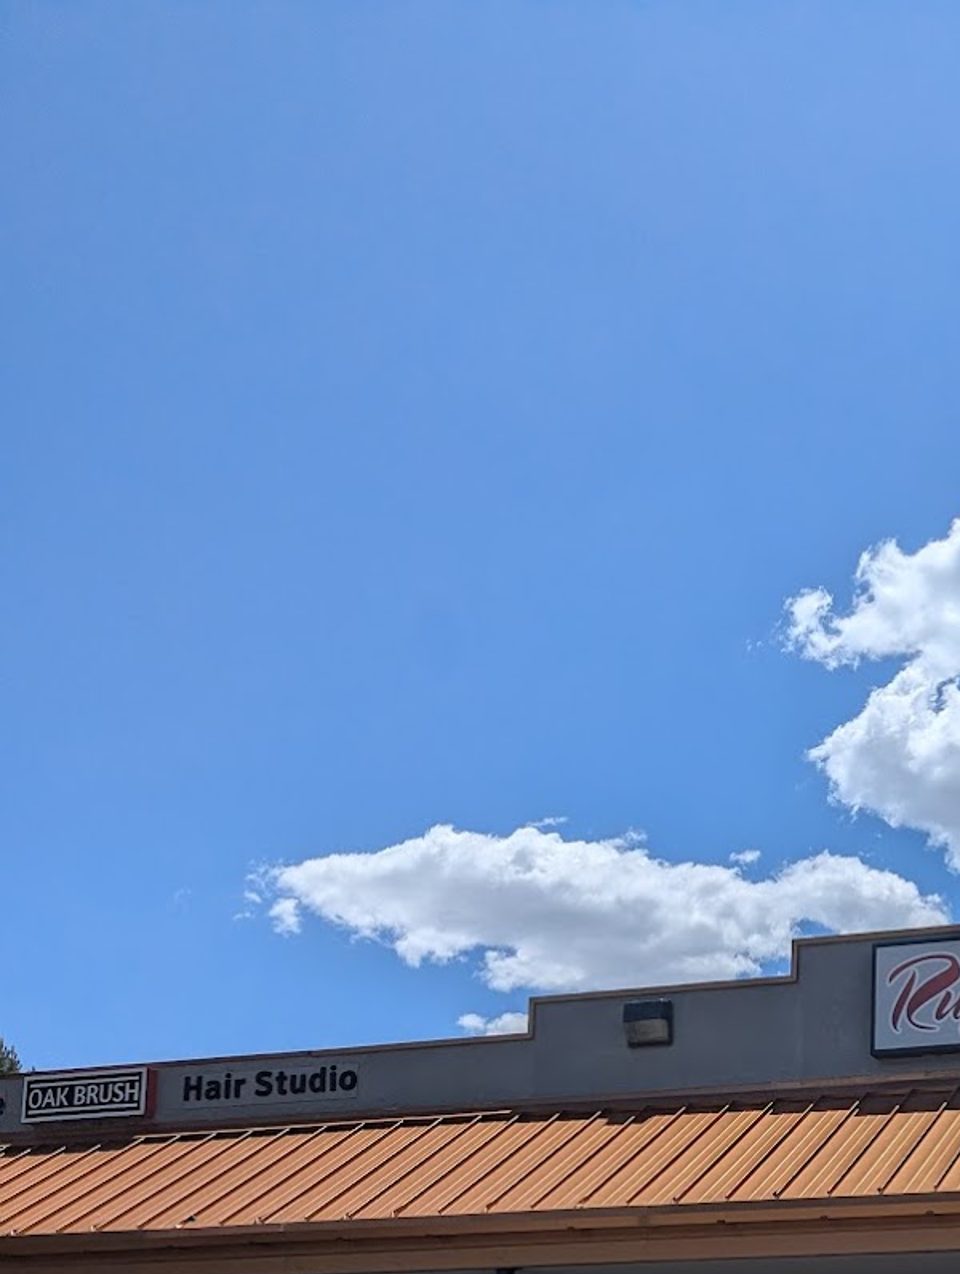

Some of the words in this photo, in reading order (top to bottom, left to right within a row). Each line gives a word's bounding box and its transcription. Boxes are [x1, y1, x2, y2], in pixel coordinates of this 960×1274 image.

[28, 1086, 68, 1110] OAK
[73, 1082, 139, 1106] BRUSH
[183, 1073, 245, 1102] Hair
[255, 1065, 358, 1097] Studio
